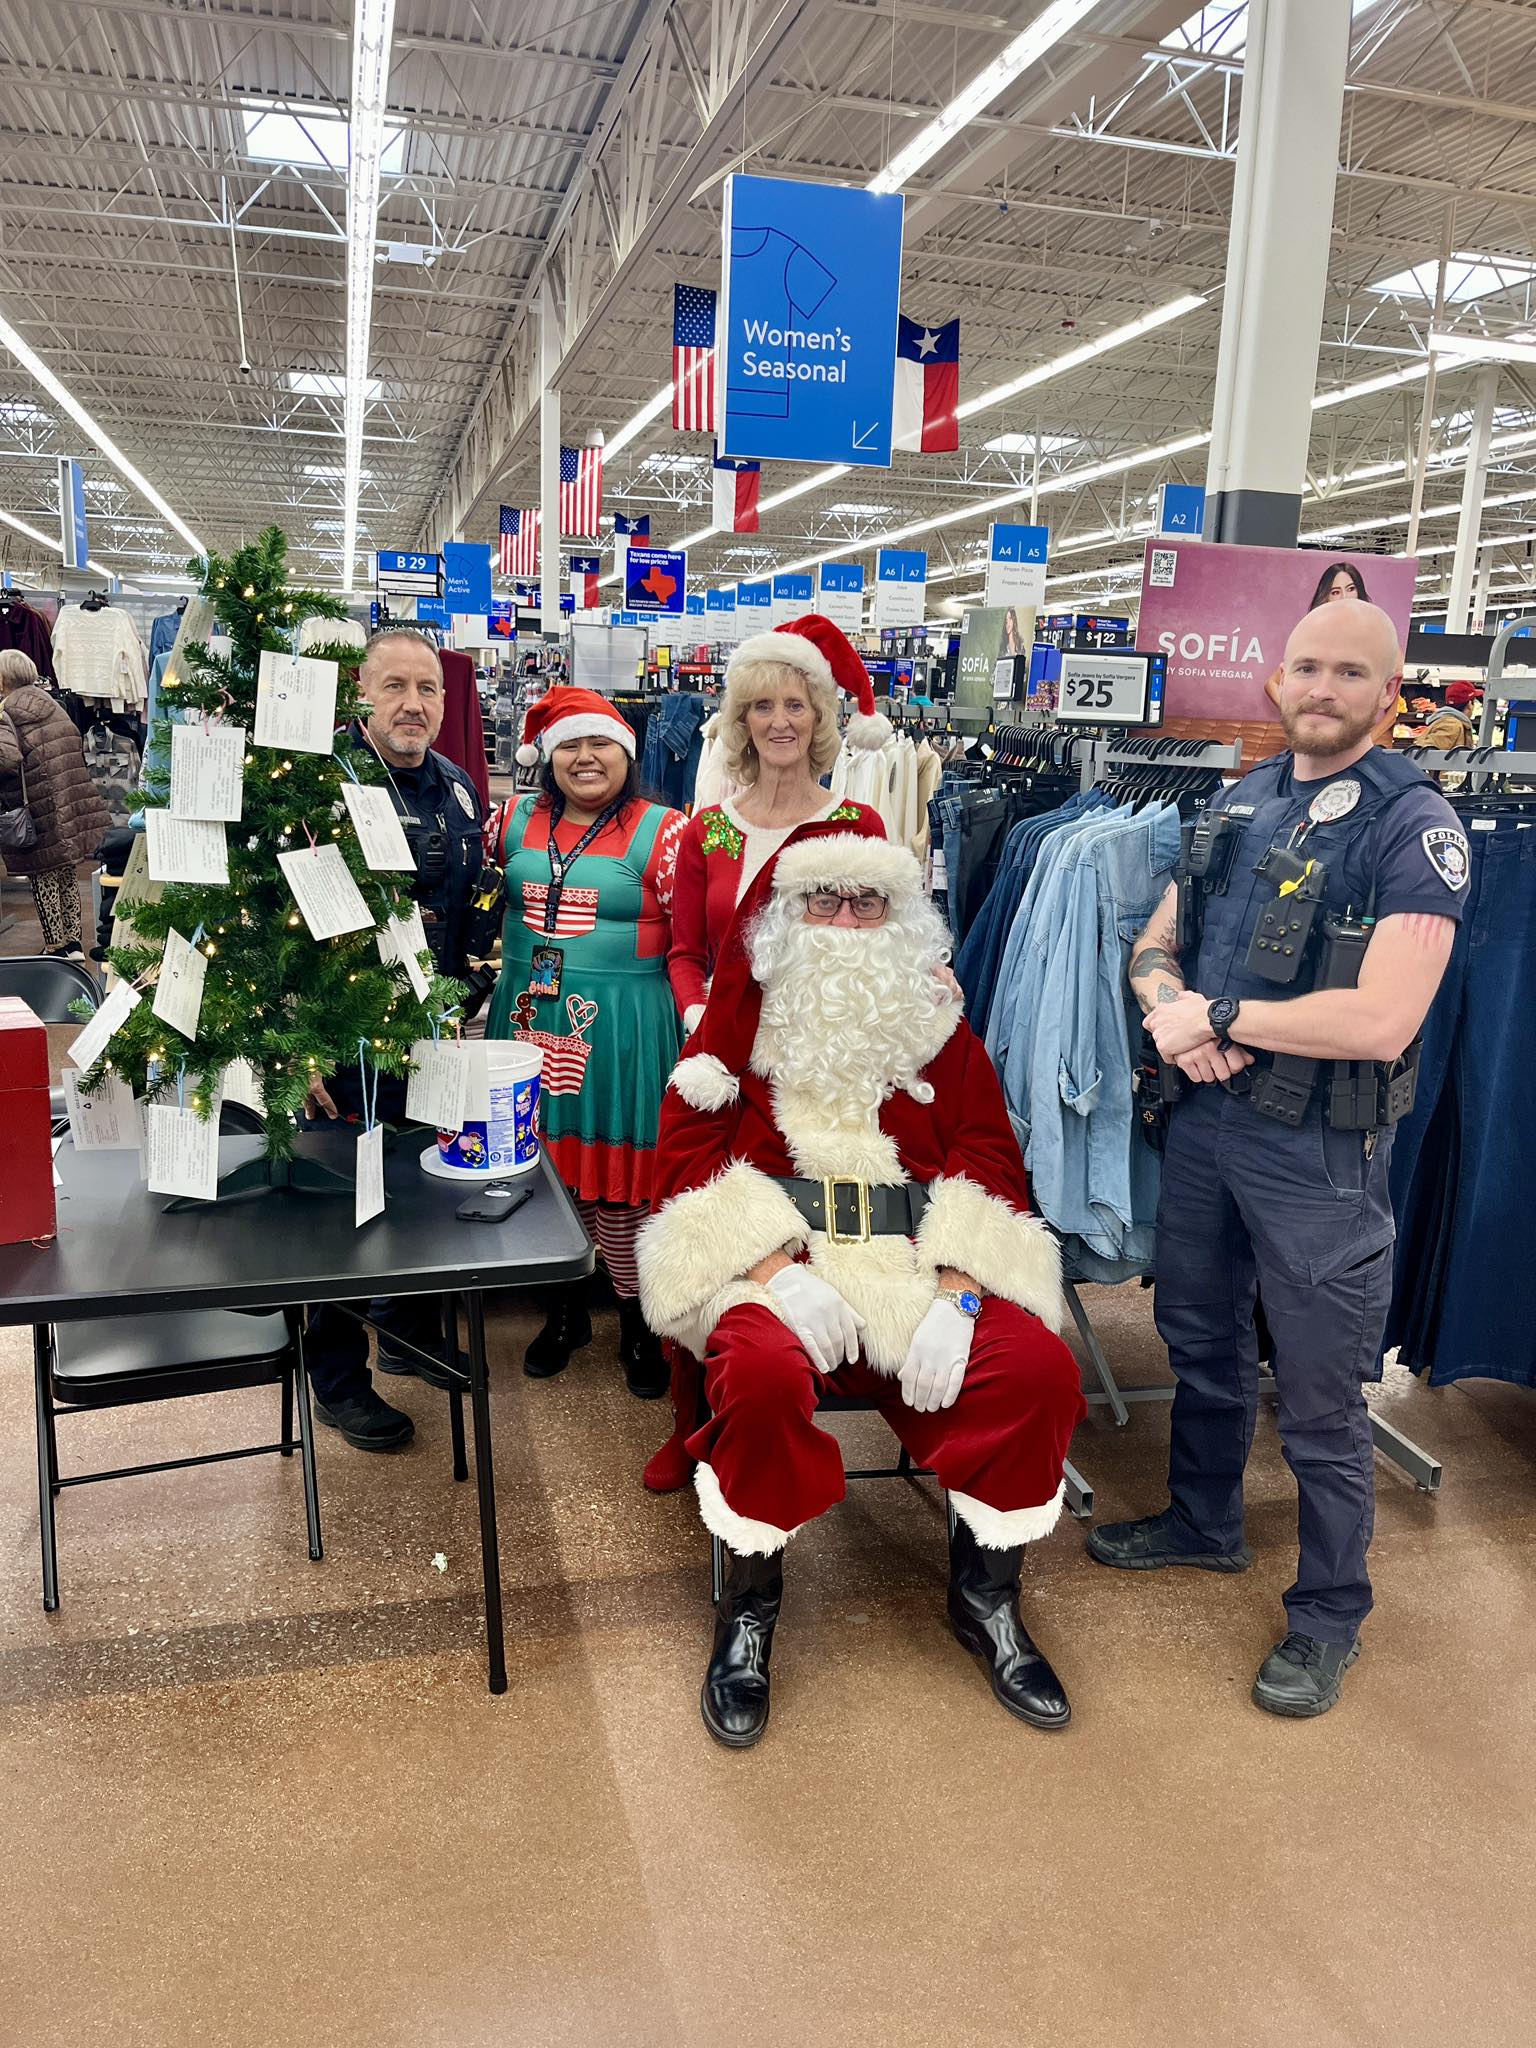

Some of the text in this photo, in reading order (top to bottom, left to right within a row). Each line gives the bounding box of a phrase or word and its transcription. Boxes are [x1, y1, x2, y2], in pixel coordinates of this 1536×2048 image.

[743, 319, 851, 352] Women's
[742, 352, 847, 383] Seasonal
[1171, 513, 1187, 525] A2
[998, 547, 1012, 556] A4
[1028, 548, 1040, 557] A5
[397, 556, 426, 569] B 29
[885, 568, 896, 576] A6
[909, 569, 920, 577] A7
[419, 602, 432, 611] Baby
[1158, 627, 1264, 664] SOFÍA
[961, 652, 989, 673] SOFÍA
[1178, 667, 1207, 677] SOFIA
[1209, 669, 1254, 680] VERGARA
[1066, 678, 1114, 708] $25
